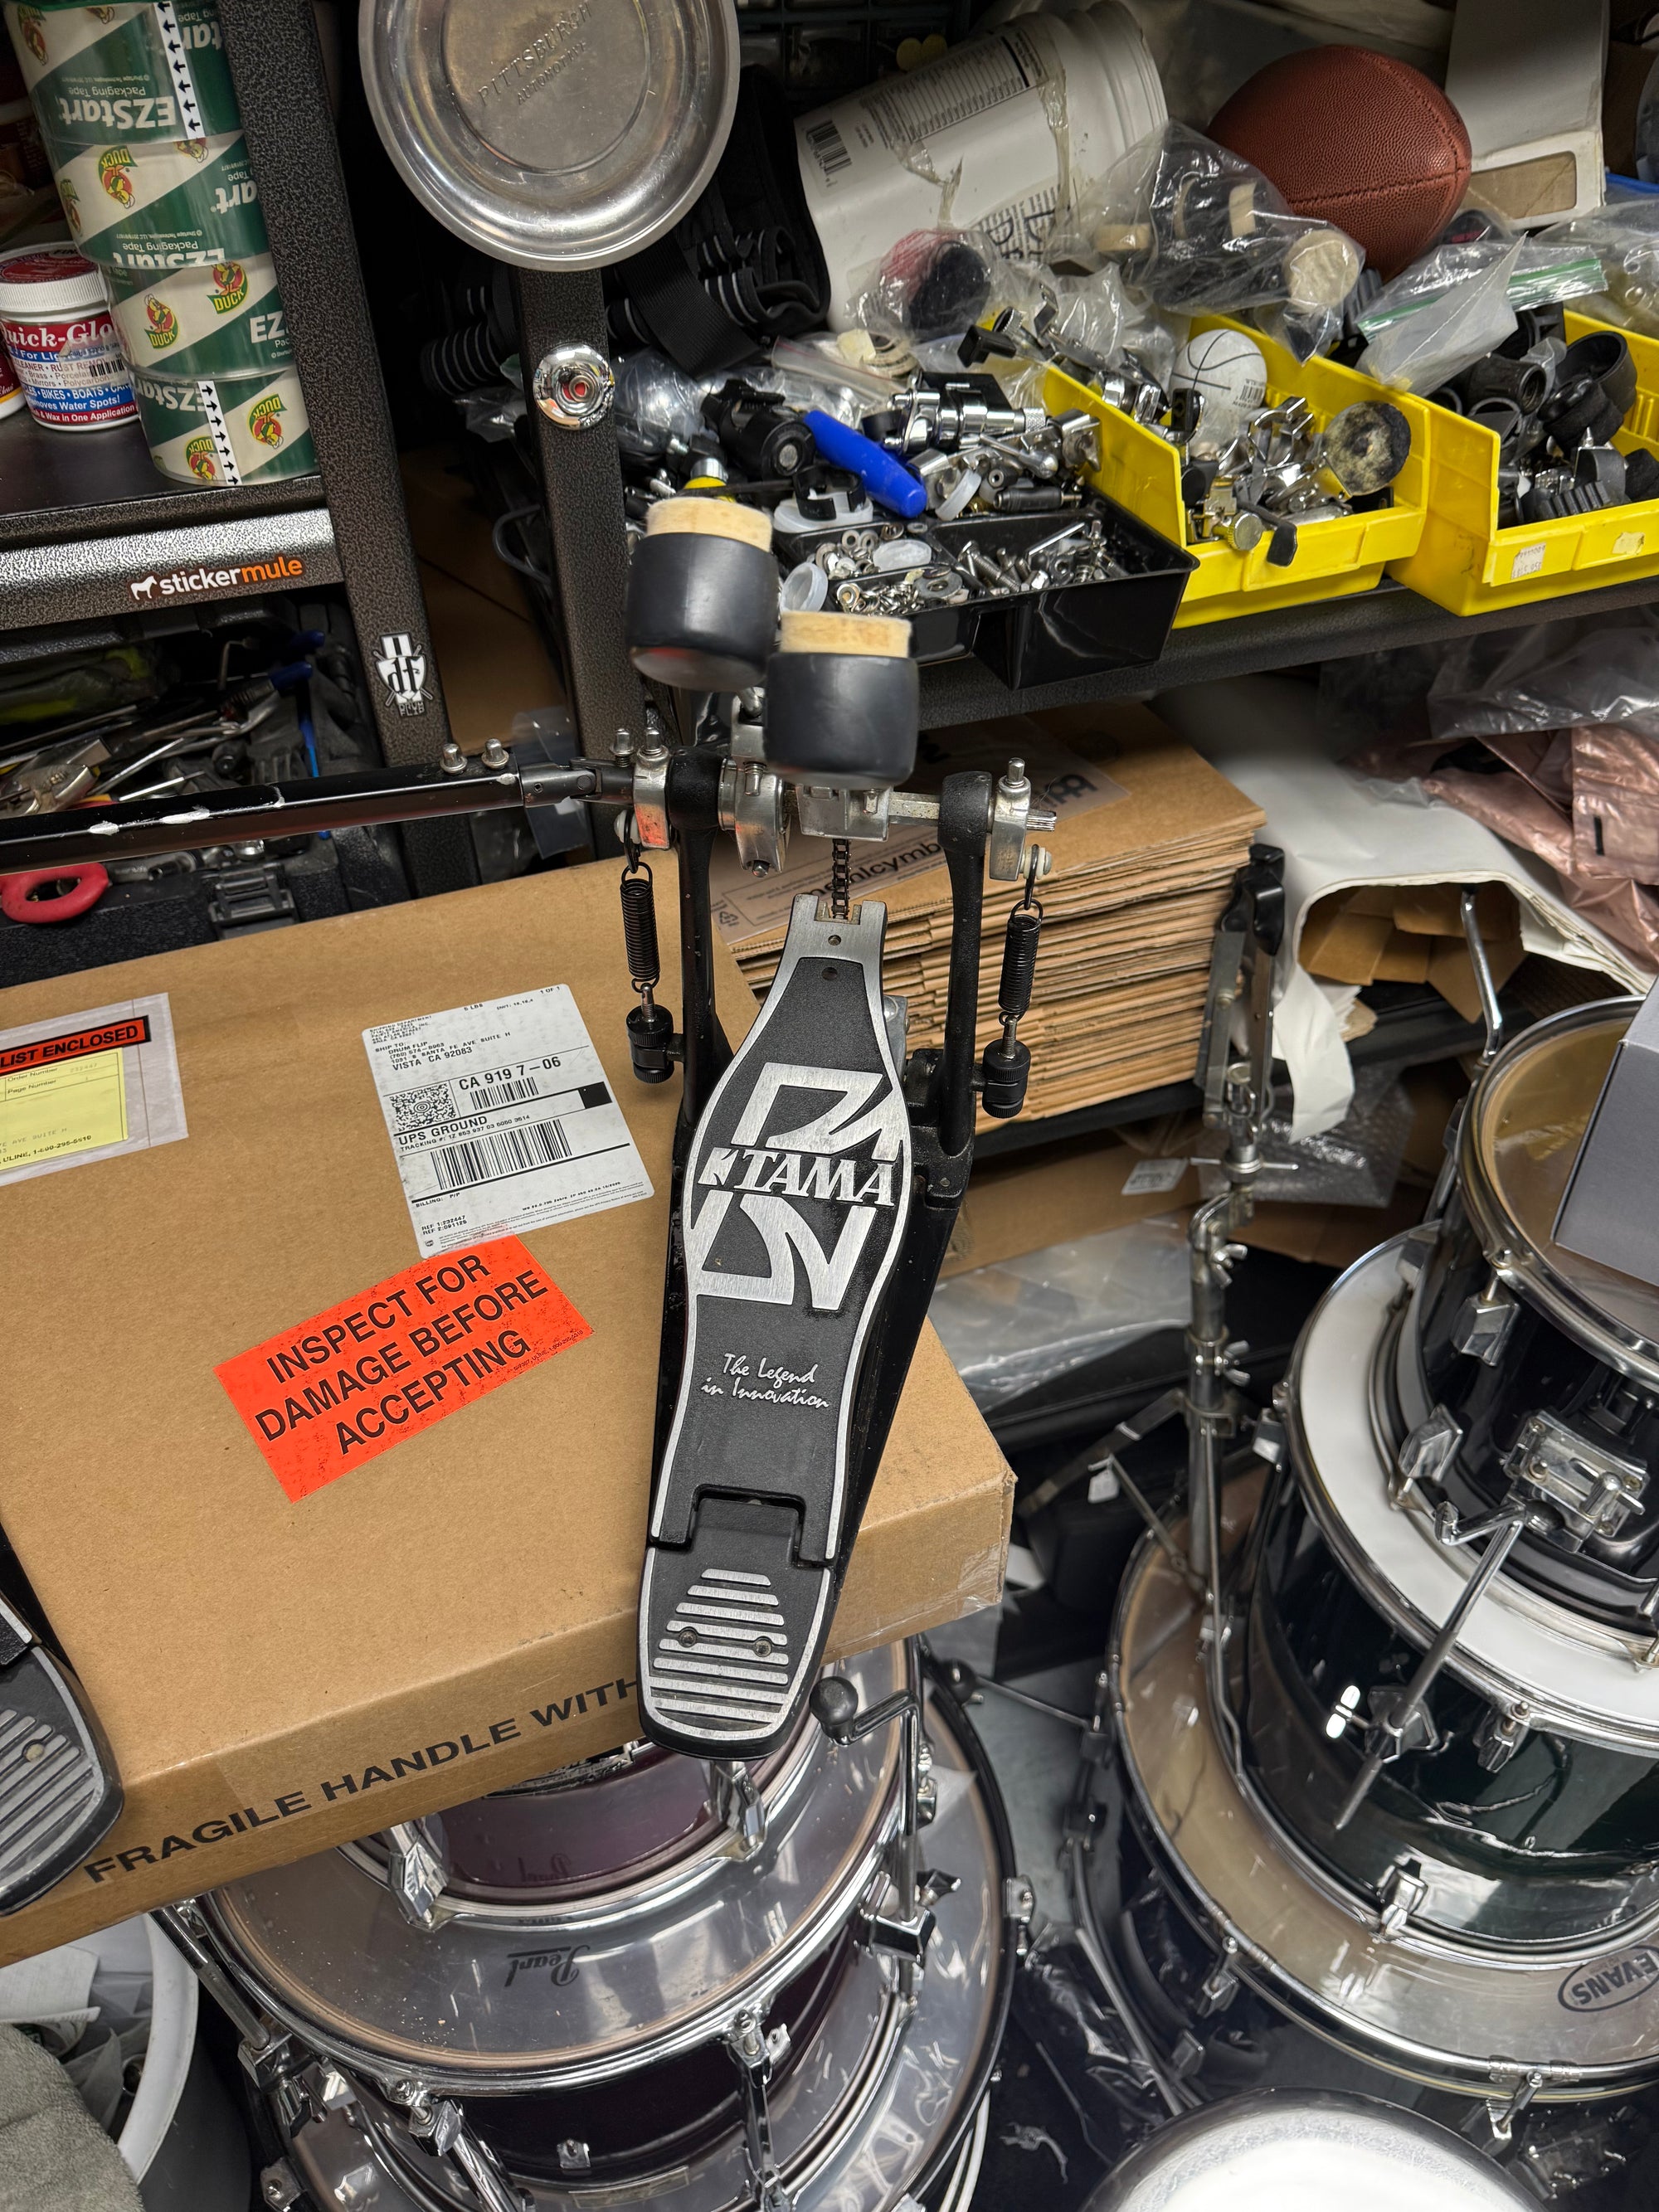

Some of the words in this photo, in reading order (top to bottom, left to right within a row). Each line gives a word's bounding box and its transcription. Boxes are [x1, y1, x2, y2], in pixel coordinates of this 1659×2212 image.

[478, 1, 592, 106] PITTSBURGH
[68, 86, 91, 97] Tape
[93, 85, 146, 97] Packaging
[59, 95, 177, 130] EZStart
[101, 148, 130, 167] DUCK
[123, 241, 145, 252] Tape
[146, 241, 199, 253] Packaging
[214, 290, 244, 312] DUCK
[6, 320, 114, 348] uick-Glo
[149, 332, 175, 348] DUCK
[41, 388, 66, 400] BIKES
[72, 386, 105, 400] BOATS
[59, 401, 86, 411] Water
[90, 395, 120, 409] Spots!
[71, 413, 89, 422] One
[90, 405, 135, 421] Application
[253, 396, 281, 419] DUCK
[188, 439, 214, 453] DUCK
[159, 556, 304, 597] stickermule
[0, 1048, 39, 1067] LIST
[42, 1025, 139, 1057] ENCLOSED
[388, 1045, 411, 1054] DRUM
[421, 1048, 445, 1057] SANTA
[480, 1034, 501, 1043] SUITE
[392, 1058, 422, 1071] VISTA
[445, 1046, 473, 1058] 92083
[7, 1074, 27, 1082] Order
[30, 1067, 58, 1077] Number
[459, 1077, 480, 1091] CA
[484, 1070, 513, 1086] 919
[7, 1086, 27, 1095] Page
[28, 1080, 57, 1090] Number
[398, 1131, 426, 1145] UPS
[431, 1116, 488, 1137] GROUND
[401, 1138, 437, 1152] TRACKING
[2, 1151, 32, 1163] ULINE,
[734, 1148, 896, 1208] TAMA
[416, 1197, 444, 1208] BILLING:
[266, 1289, 414, 1384] INSPECT
[415, 1254, 492, 1305] FOR
[255, 1341, 411, 1441] DAMAGE
[409, 1269, 549, 1358] BEFORE
[722, 1352, 751, 1377] The
[757, 1358, 819, 1384] Legend
[335, 1330, 532, 1455] ACCEPTING
[701, 1378, 724, 1395] in
[732, 1376, 830, 1409] Innovation
[84, 1790, 313, 1884] FRAGILE
[320, 1718, 523, 1802] HANDLE
[529, 1678, 640, 1728] WITH
[504, 1945, 591, 1987] Pearl
[1571, 1952, 1659, 2005] EVANS
